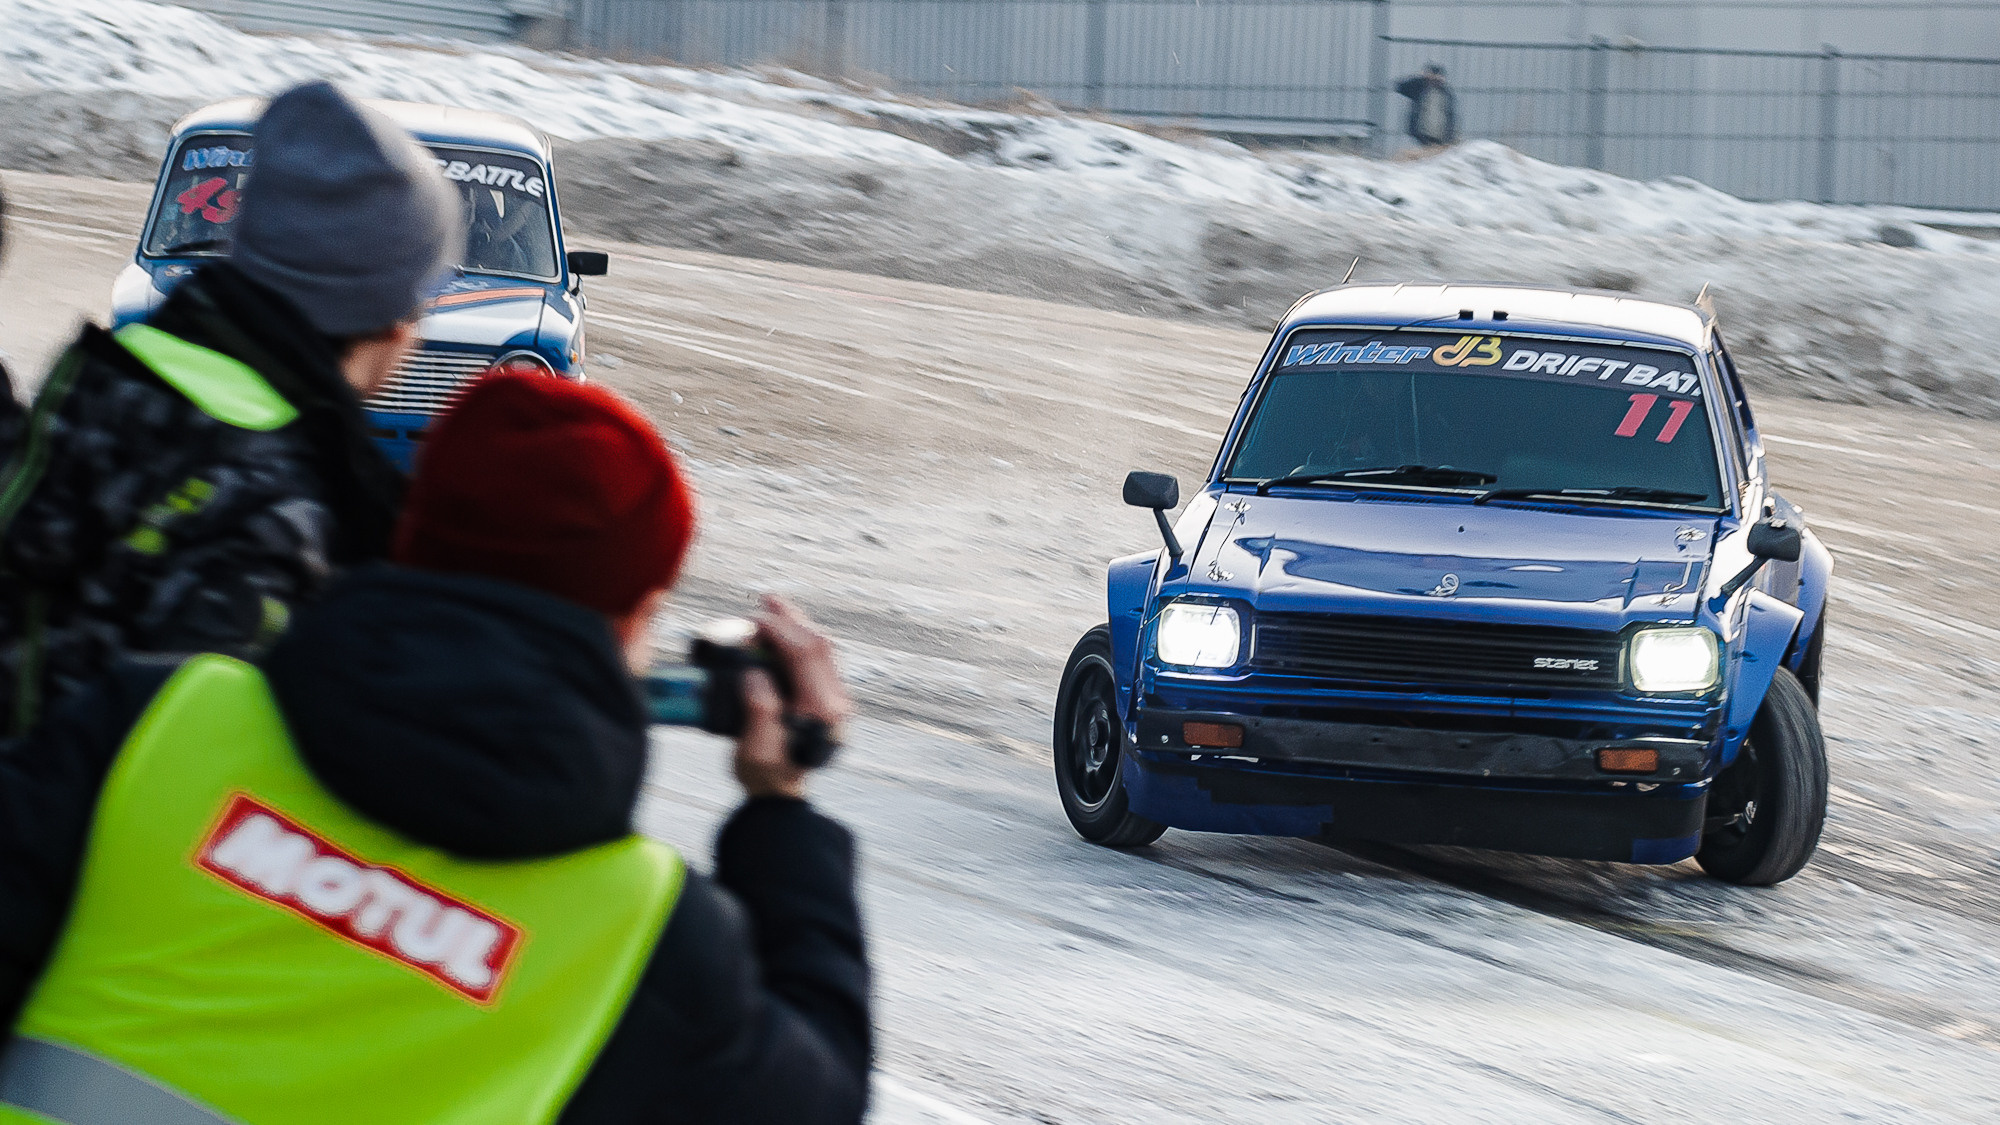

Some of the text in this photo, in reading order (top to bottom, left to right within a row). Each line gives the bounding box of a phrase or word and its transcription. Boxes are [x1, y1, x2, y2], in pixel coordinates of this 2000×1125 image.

[442, 160, 544, 198] BATTLE
[1283, 341, 1433, 367] Winter
[1501, 349, 1631, 380] DRIFT
[1614, 393, 1695, 443] 11
[211, 812, 500, 989] MOTUL
